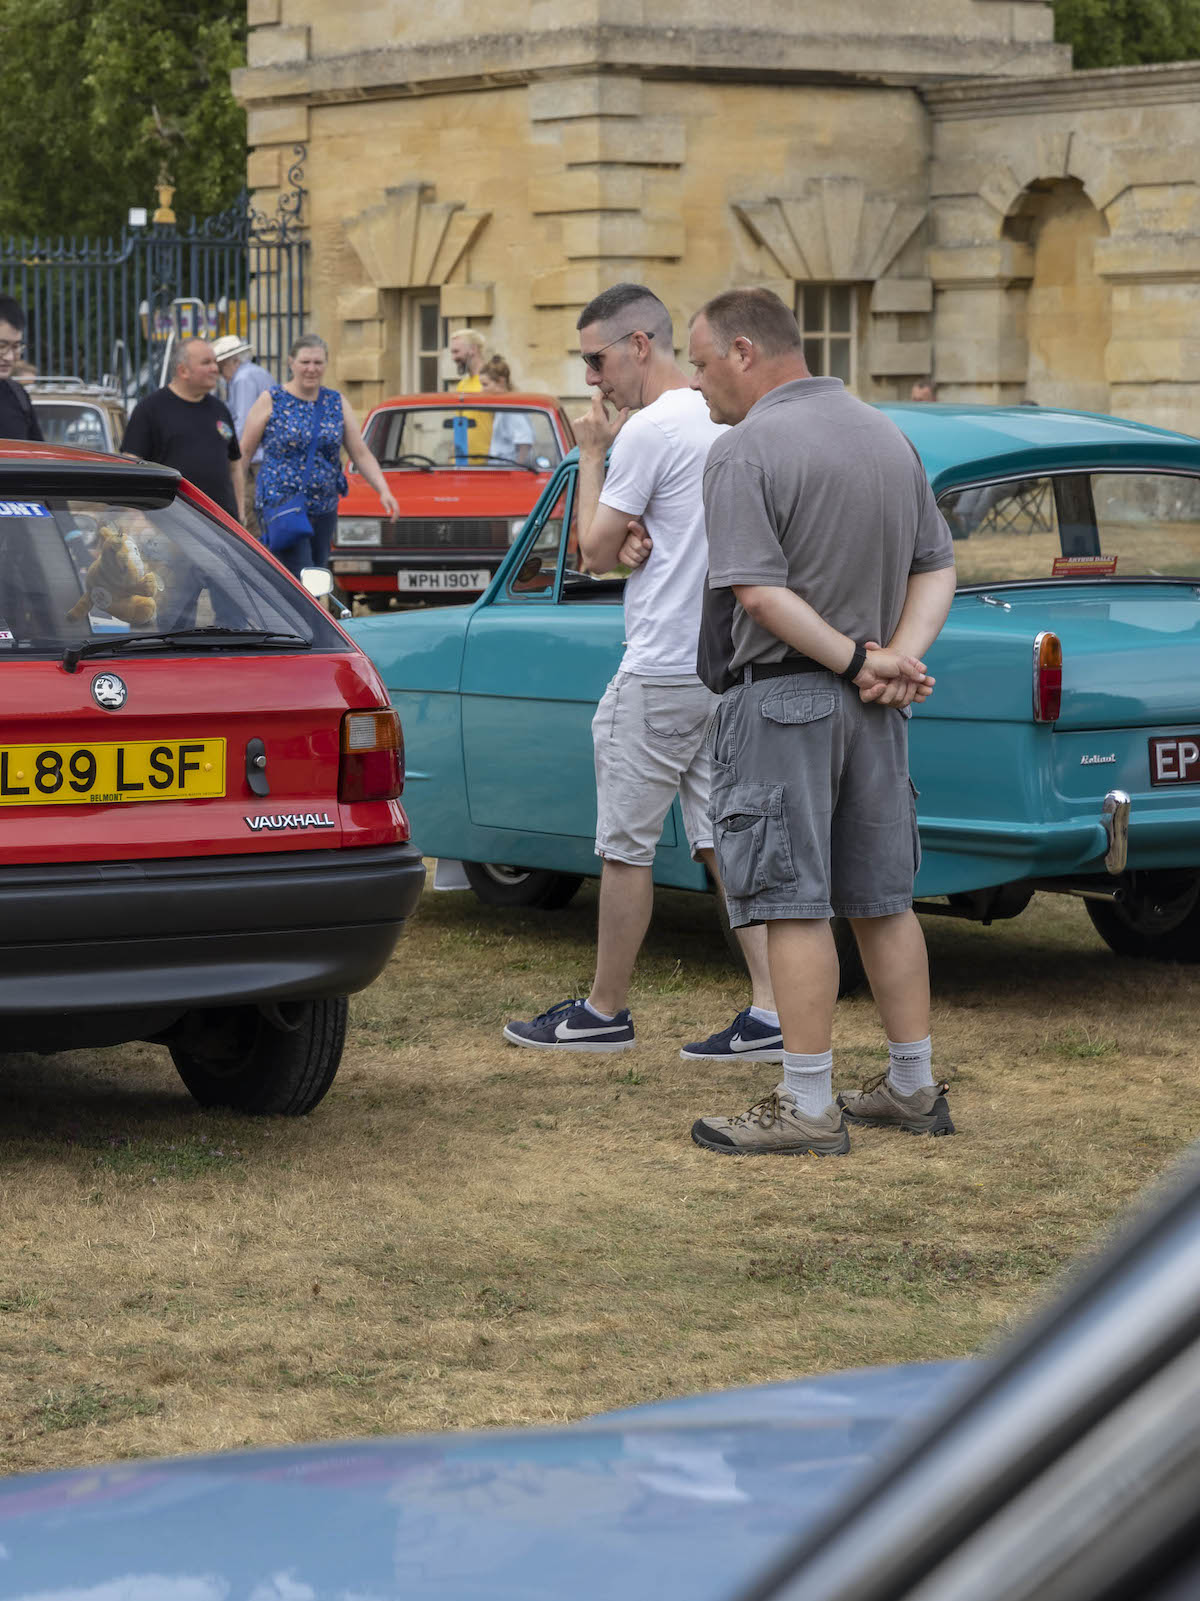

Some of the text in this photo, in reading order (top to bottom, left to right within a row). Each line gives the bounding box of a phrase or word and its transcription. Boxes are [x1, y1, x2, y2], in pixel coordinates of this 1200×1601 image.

[408, 573, 479, 588] WPH 190Y
[0, 744, 205, 796] L89 LSF
[90, 793, 123, 802] BELMONT
[244, 813, 335, 830] VAUXHALL
